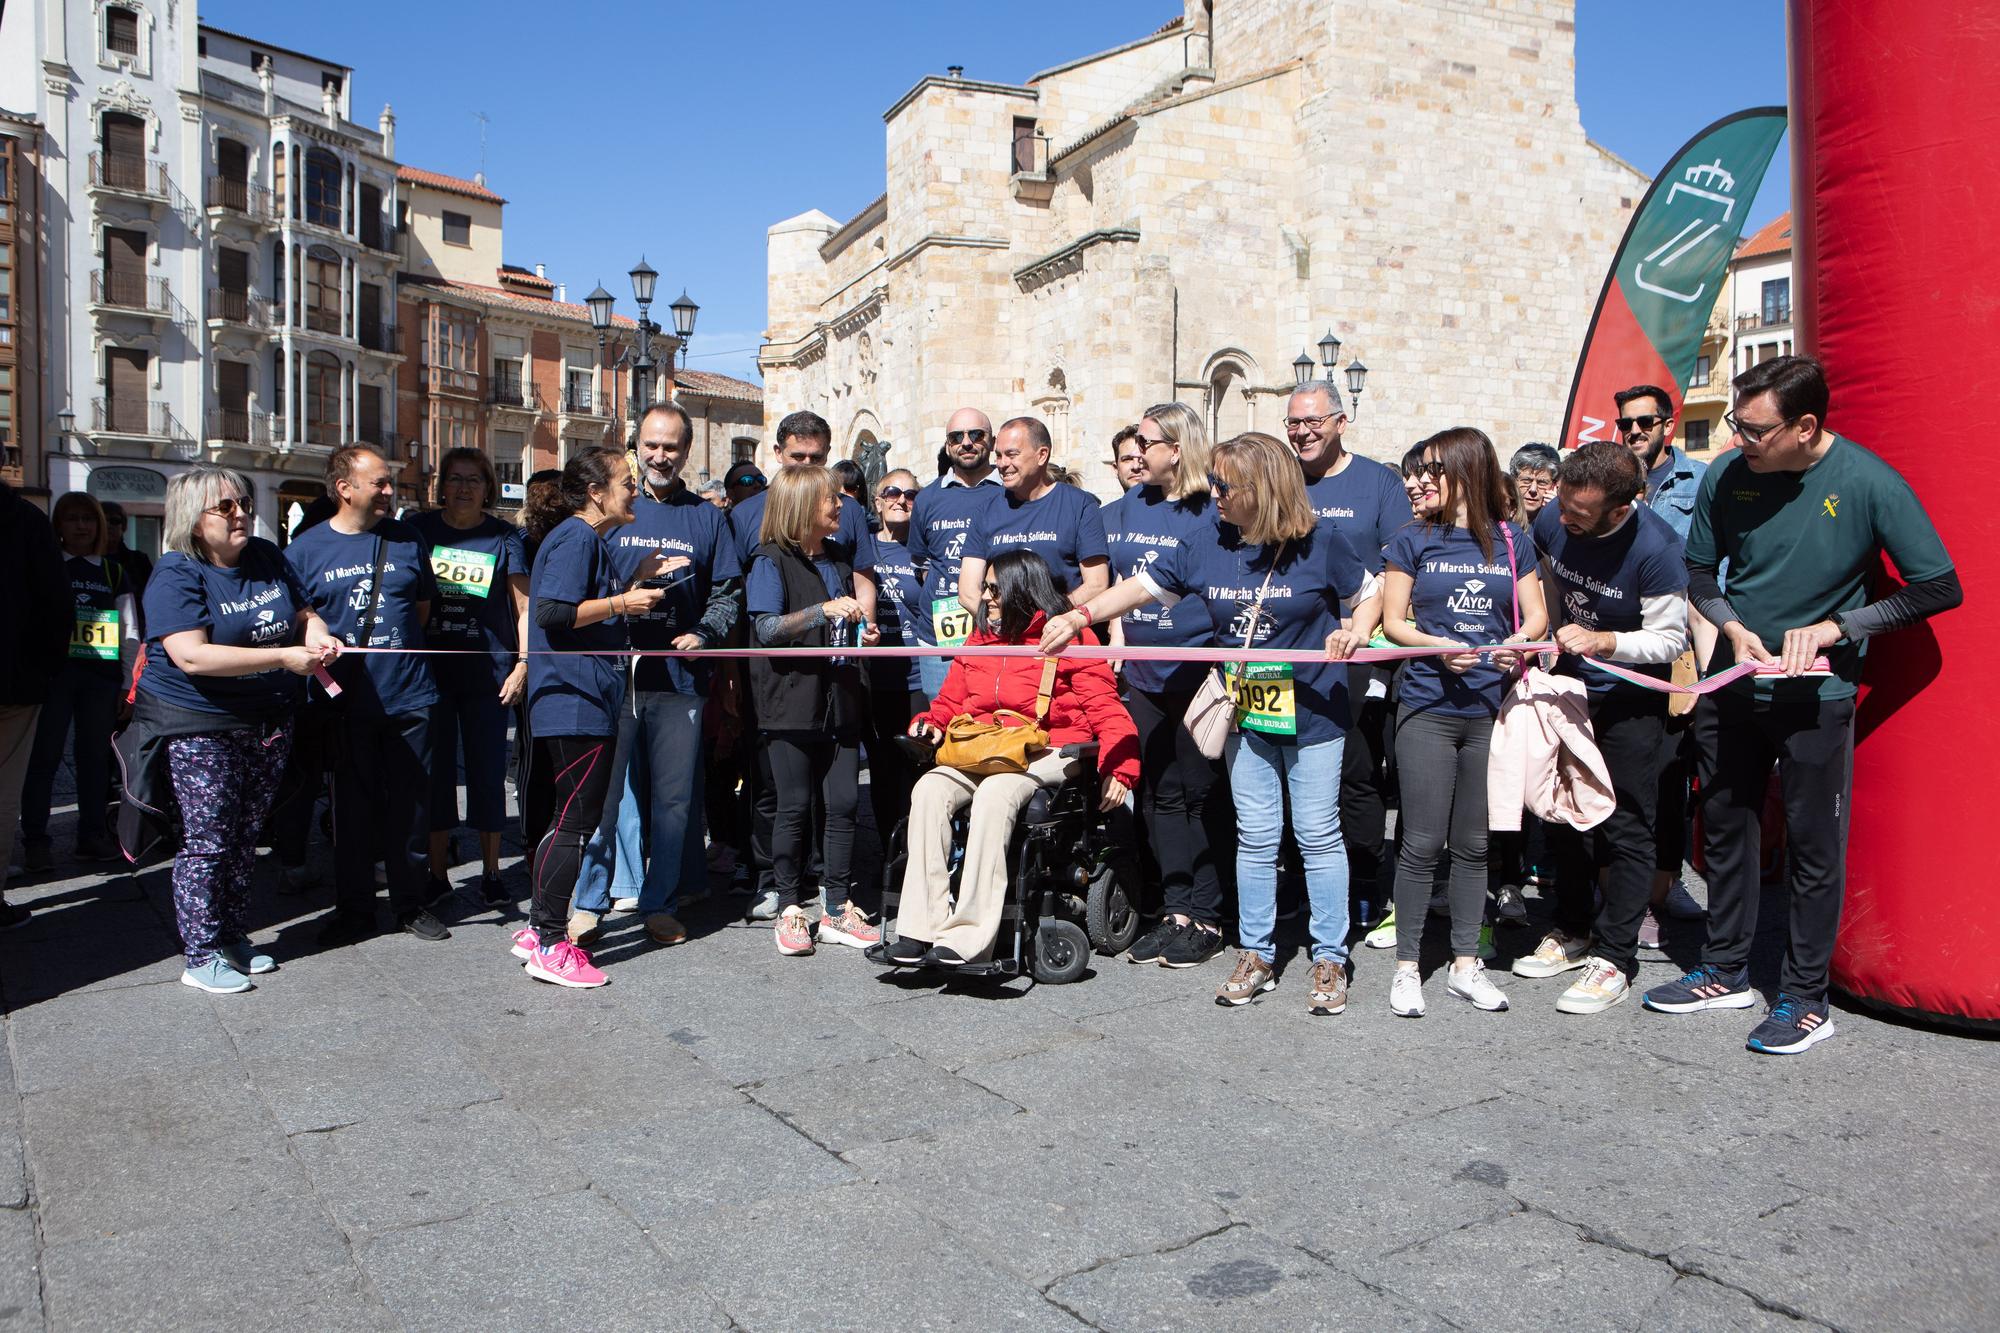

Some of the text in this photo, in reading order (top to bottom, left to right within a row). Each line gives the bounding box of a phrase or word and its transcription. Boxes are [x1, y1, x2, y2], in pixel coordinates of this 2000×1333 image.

[1322, 507, 1354, 518] Solidaria
[941, 519, 965, 529] Marcha
[620, 536, 693, 554] IV Marcha Solidaria
[993, 531, 1057, 546] IV Marcha Solidaria
[1125, 532, 1136, 543] IV
[1133, 533, 1158, 545] Marcha
[325, 570, 335, 582] IV
[336, 564, 366, 579] Marcha
[436, 562, 485, 583] 260
[1426, 561, 1437, 573] IV
[1439, 562, 1475, 574] Marcha
[1555, 562, 1584, 585] Marcha
[1585, 576, 1623, 599] Solidaria
[1208, 586, 1219, 599] IV
[1219, 587, 1252, 600] Marcha
[1446, 588, 1493, 613] AZAYCA
[220, 602, 232, 615] IV
[251, 620, 289, 643] AZAYCA
[1264, 718, 1292, 730] RURAL
